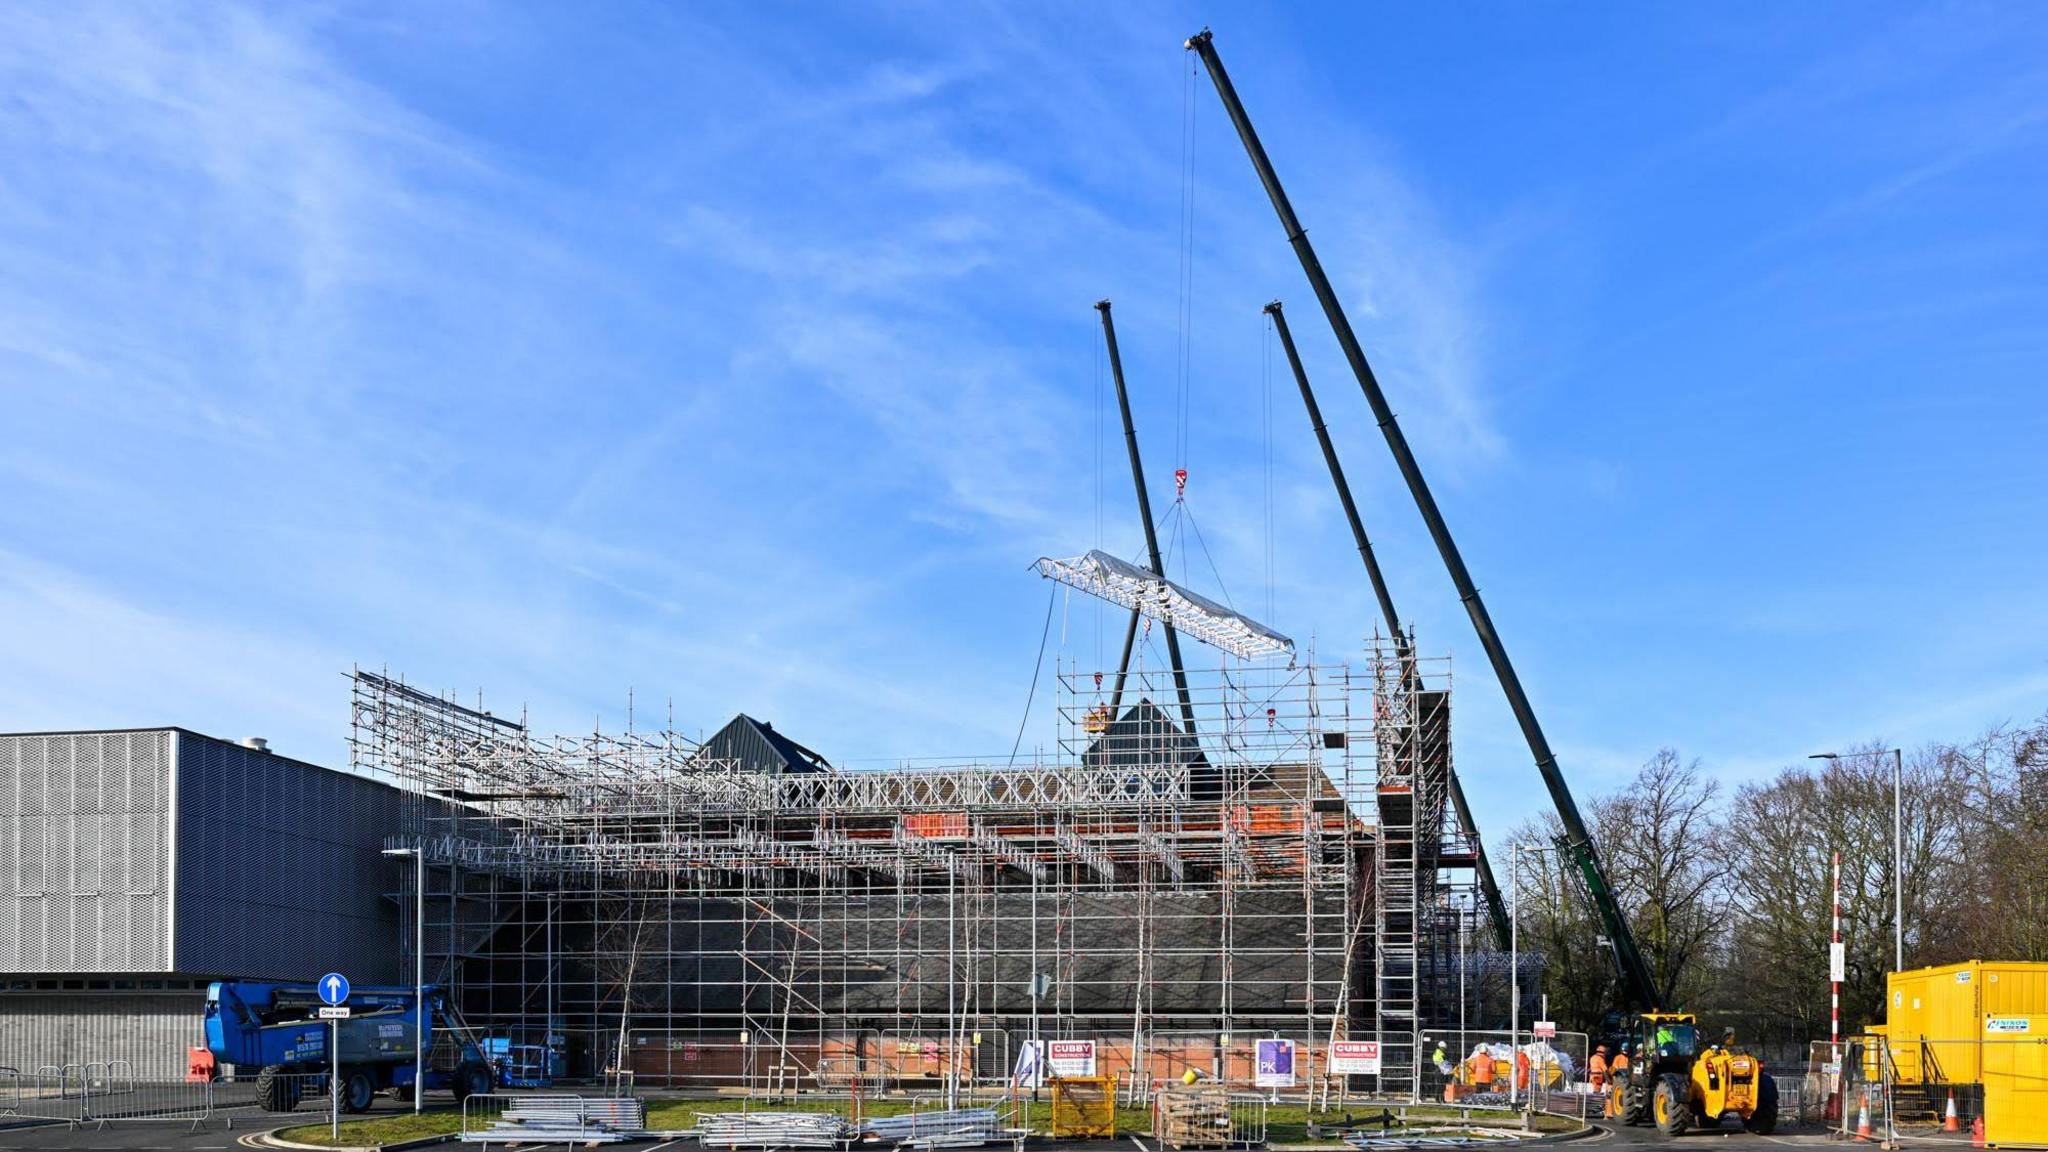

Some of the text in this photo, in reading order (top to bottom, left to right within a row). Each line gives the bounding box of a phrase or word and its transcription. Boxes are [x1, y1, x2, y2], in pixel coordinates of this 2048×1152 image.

[1055, 1044, 1090, 1052] CUBBY
[1336, 1044, 1376, 1052] CUBBY
[1260, 1061, 1277, 1073] PK
